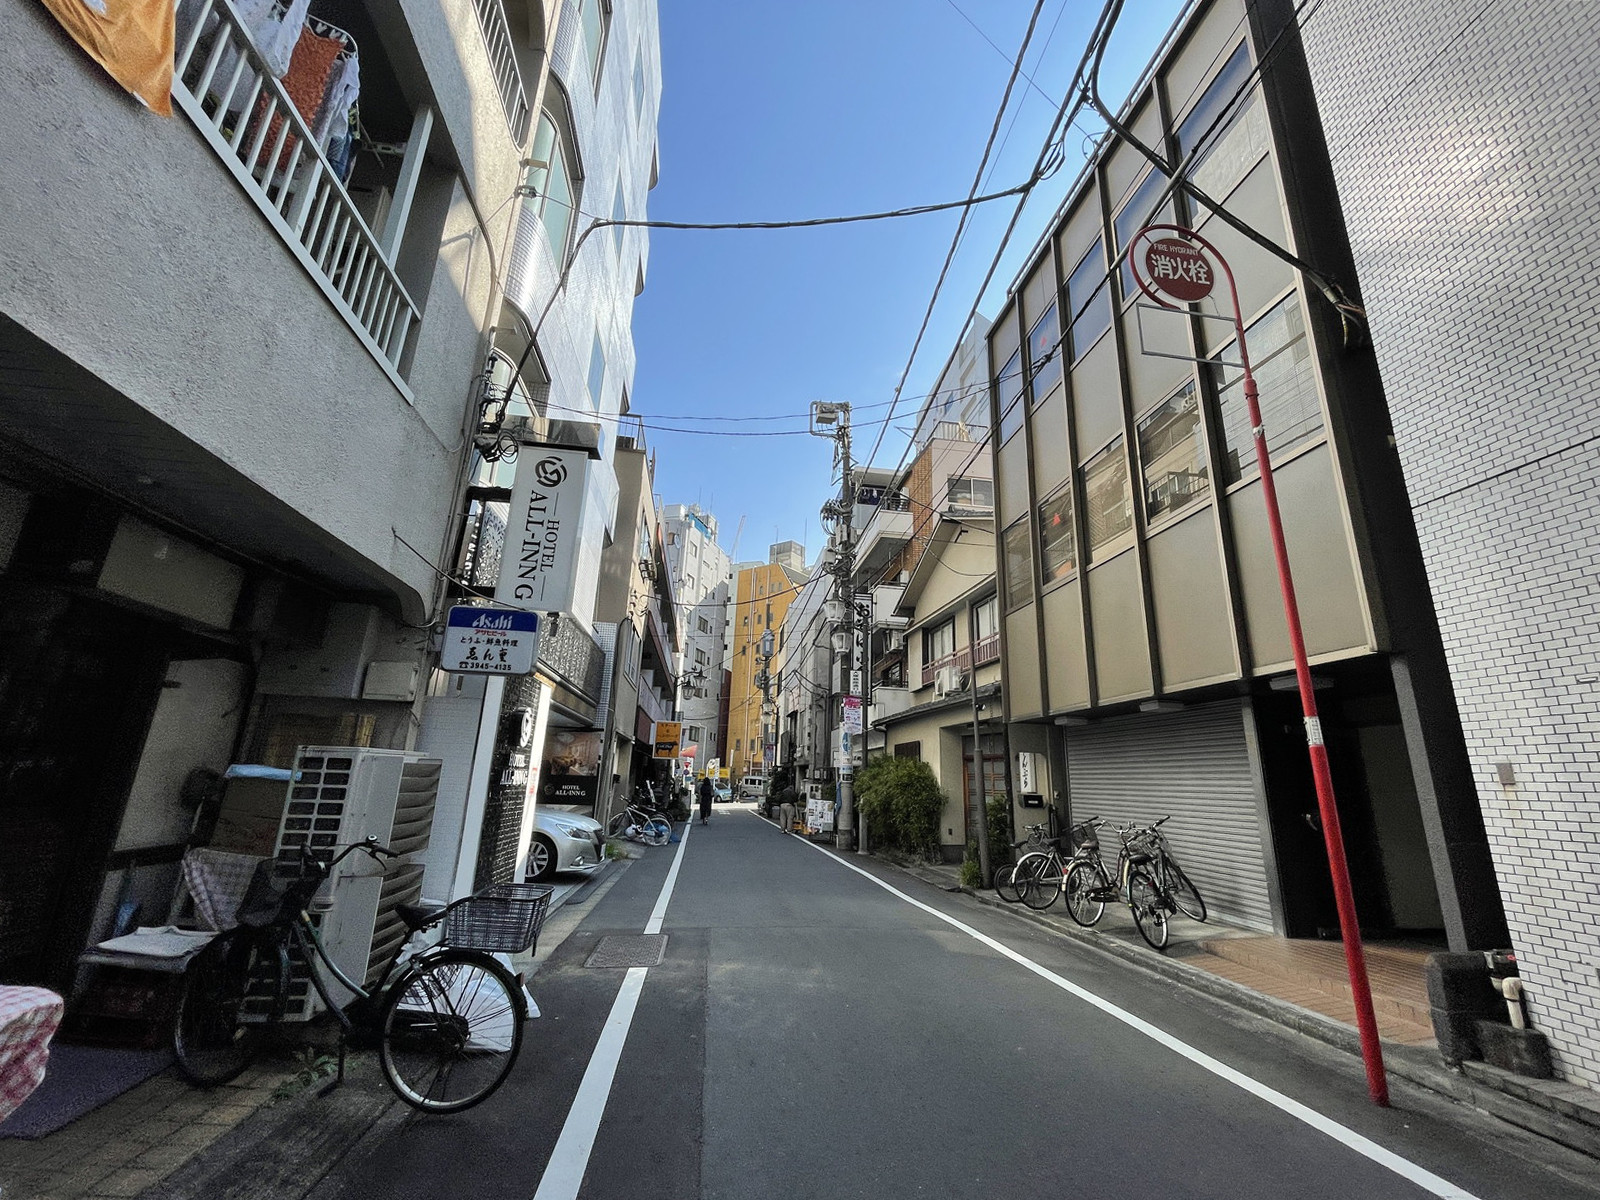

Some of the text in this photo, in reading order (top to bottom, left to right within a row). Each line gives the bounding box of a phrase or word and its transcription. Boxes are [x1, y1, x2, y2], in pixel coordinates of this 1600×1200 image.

[1153, 243, 1199, 256] FIRE HYDRANT
[1151, 253, 1210, 285] 消火栓
[540, 519, 560, 573] HOTEL
[472, 613, 513, 630] Asahi
[474, 629, 507, 637] アサヒビール
[470, 661, 512, 671] 3945-4135
